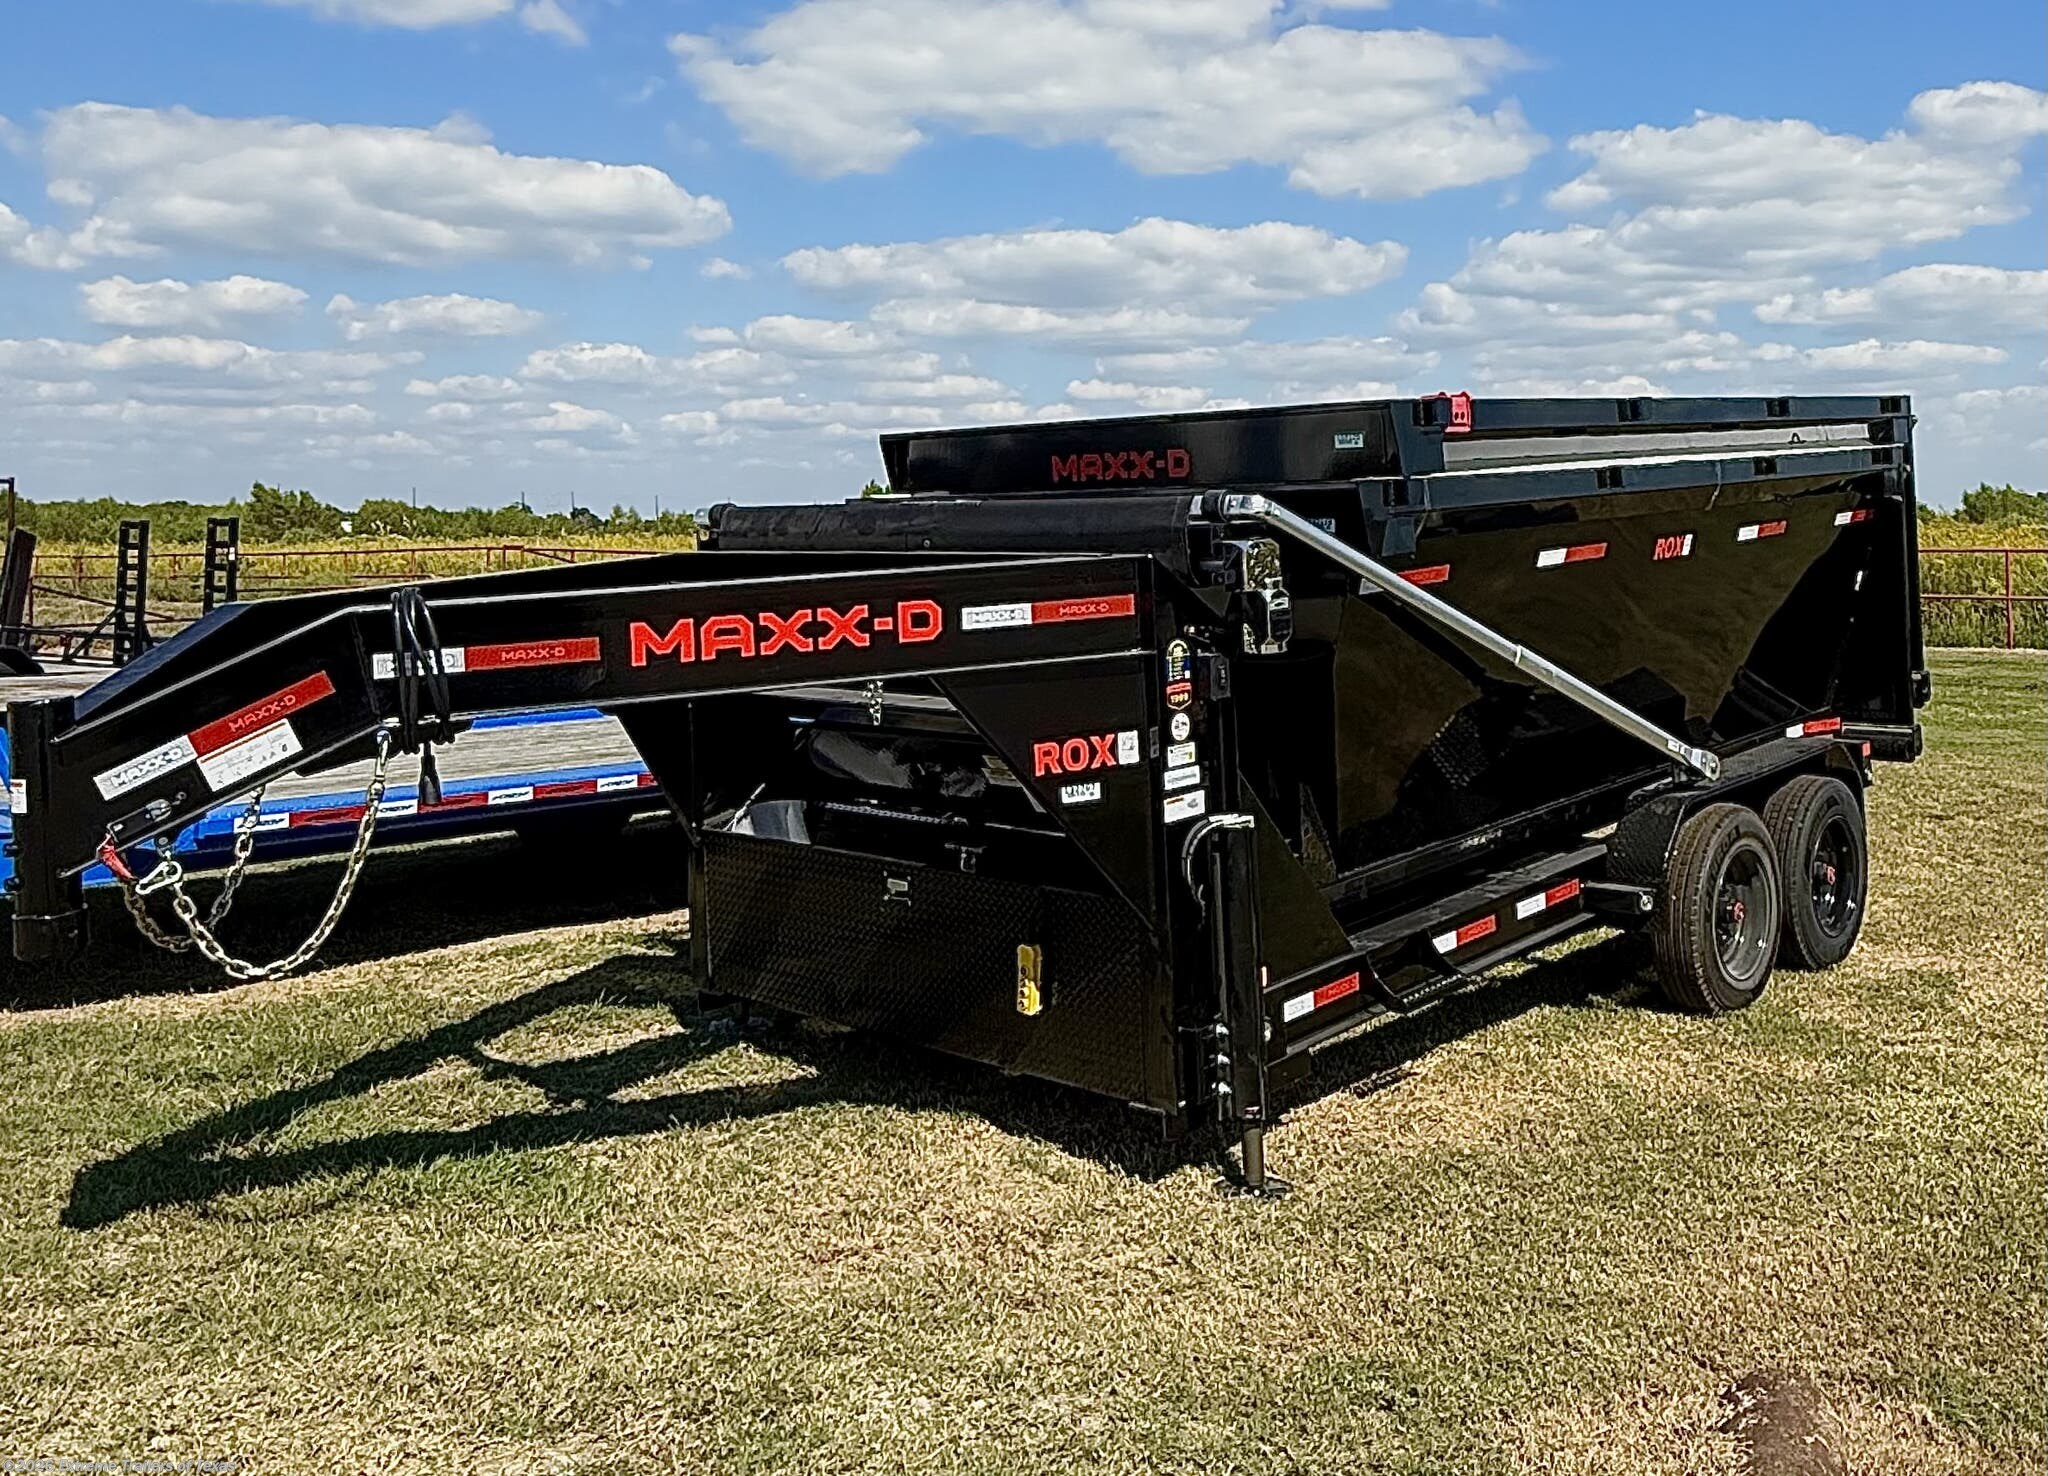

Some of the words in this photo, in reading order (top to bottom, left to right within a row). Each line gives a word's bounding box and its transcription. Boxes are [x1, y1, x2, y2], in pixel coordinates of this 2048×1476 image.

[1051, 449, 1190, 483] MAXX-D
[1653, 535, 1684, 561] ROX
[1059, 604, 1110, 616] MAXX-D
[630, 600, 943, 667] MAXX-D
[501, 647, 565, 661] MAXX-D
[229, 694, 297, 732] MAXX-D
[110, 745, 183, 788] MAXX-D
[1034, 734, 1117, 777] ROX
